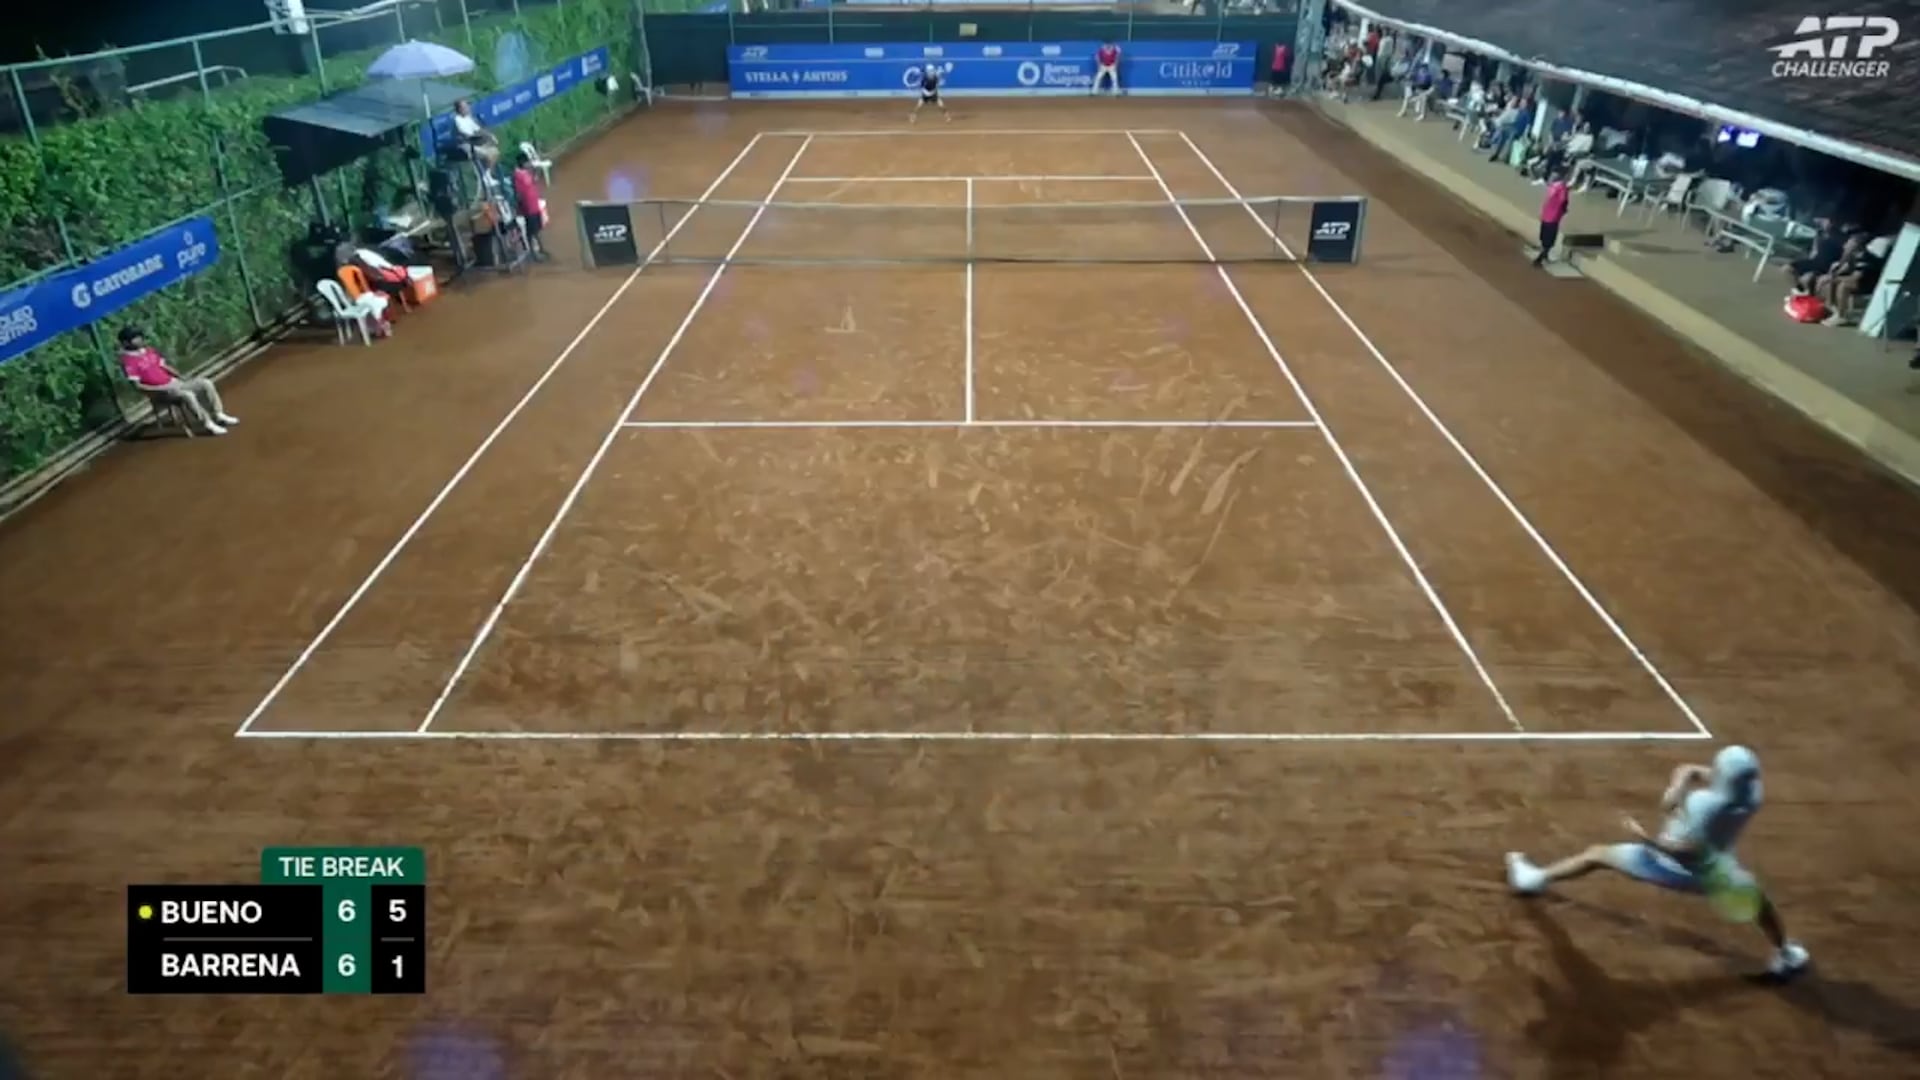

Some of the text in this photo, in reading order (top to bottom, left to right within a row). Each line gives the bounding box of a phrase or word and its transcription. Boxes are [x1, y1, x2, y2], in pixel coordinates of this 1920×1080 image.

[745, 71, 788, 83] STELLA
[594, 224, 627, 238] ATP
[1315, 222, 1351, 235] ATP
[93, 254, 164, 297] GATORADE
